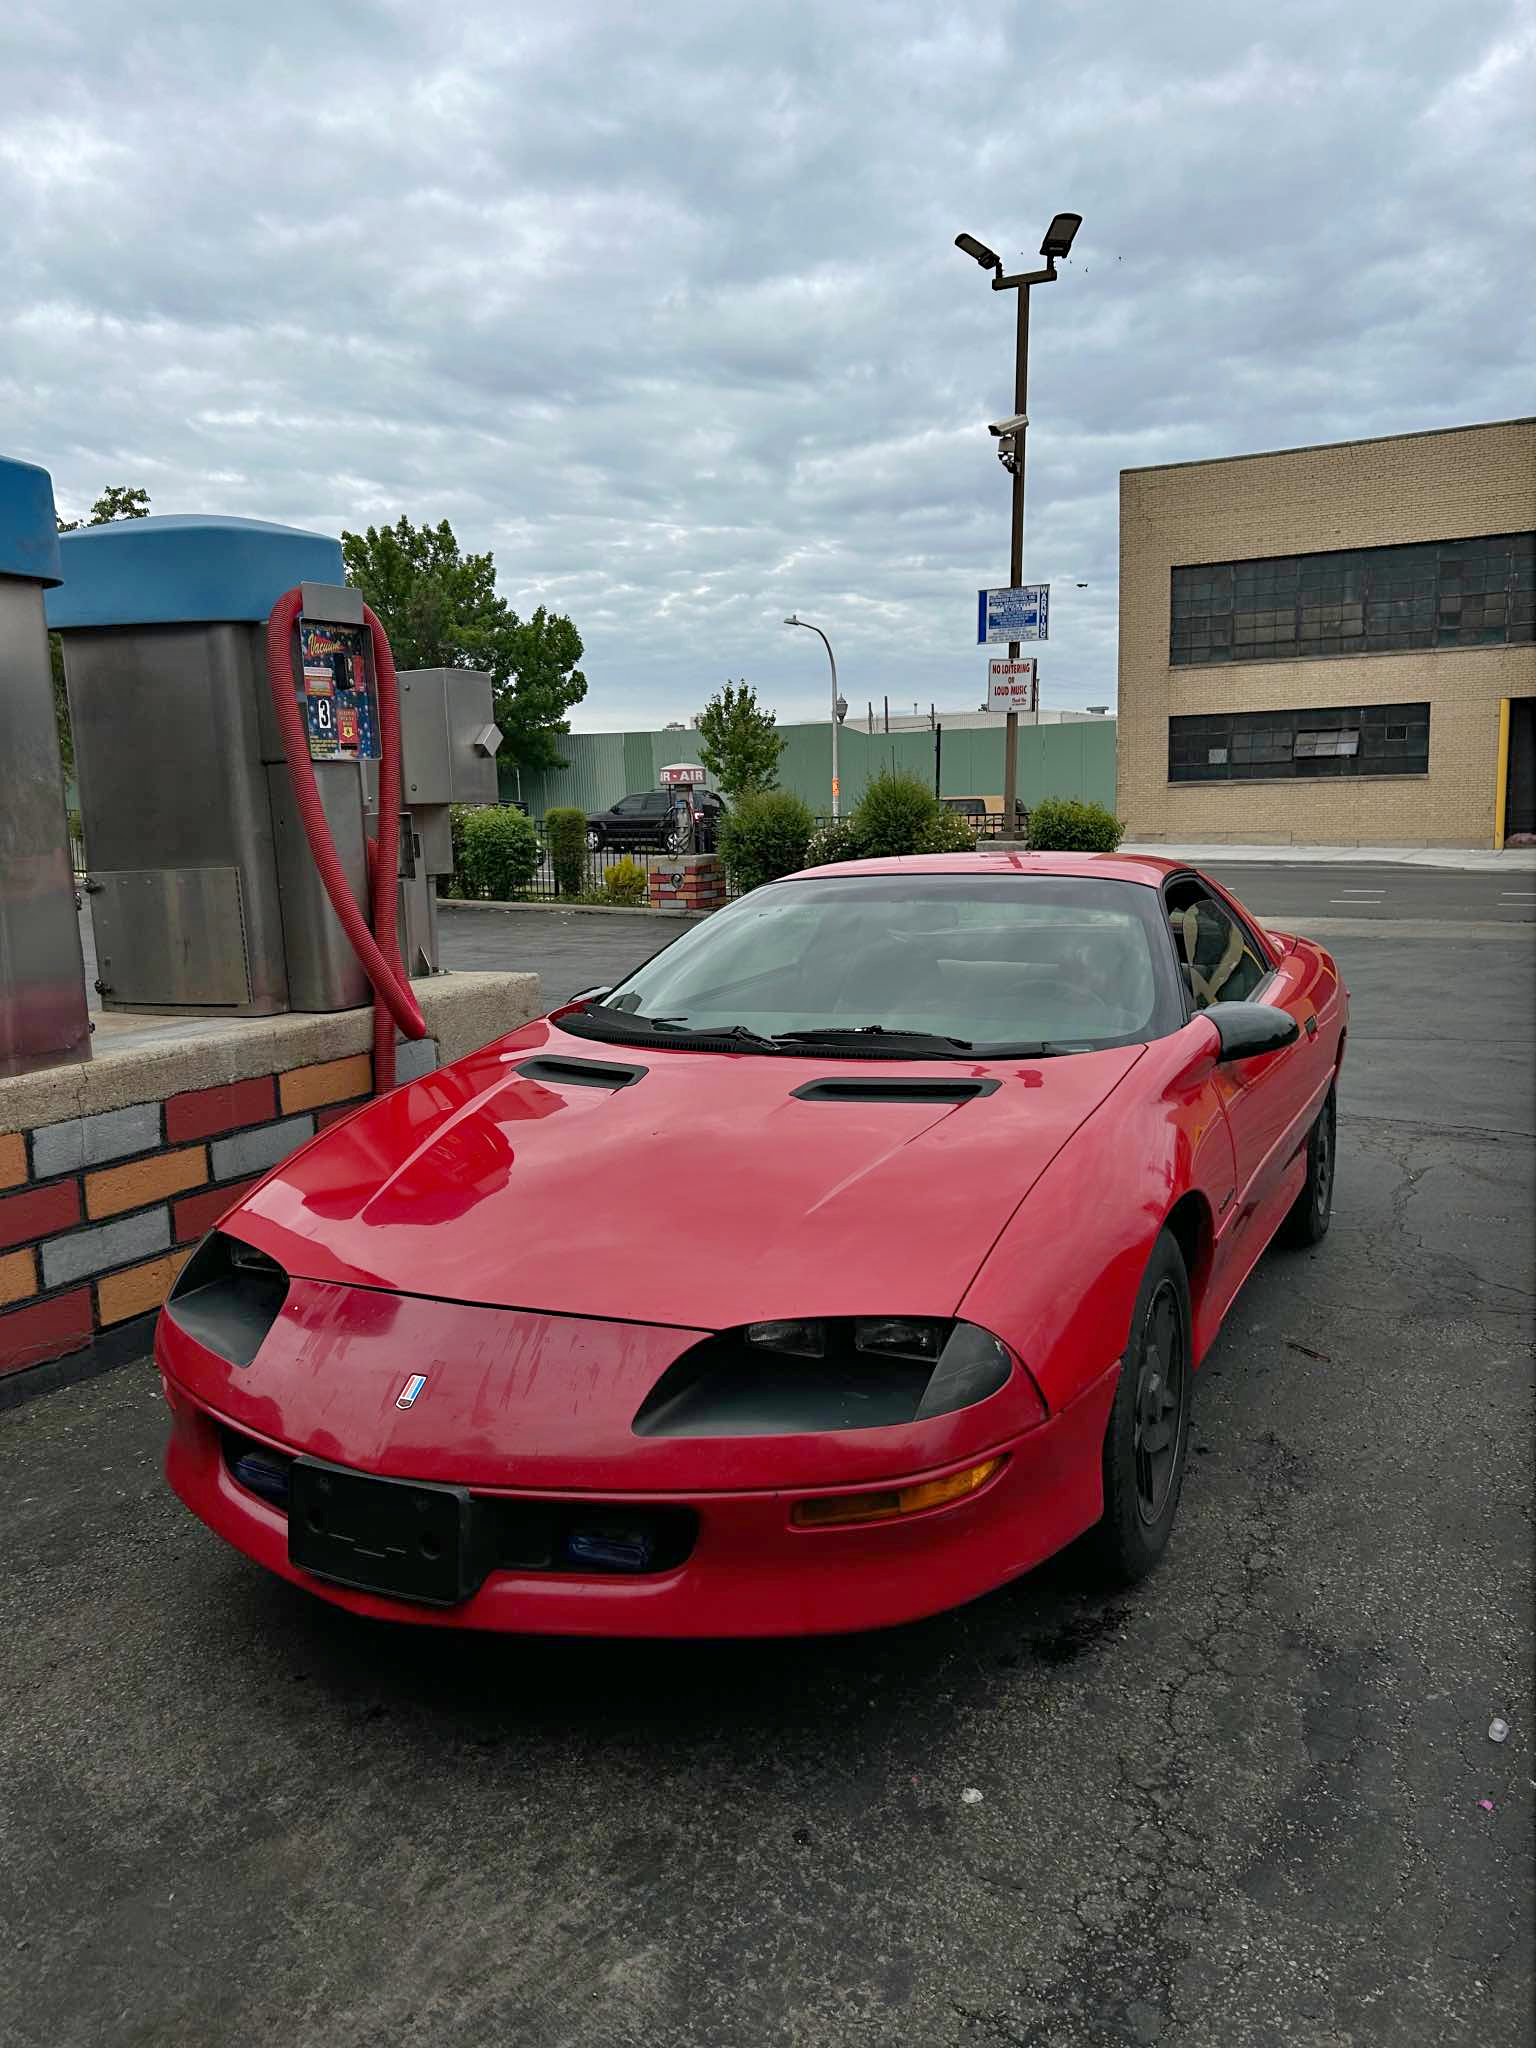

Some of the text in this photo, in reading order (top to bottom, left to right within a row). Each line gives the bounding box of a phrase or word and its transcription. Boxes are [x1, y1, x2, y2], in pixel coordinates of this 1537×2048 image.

[1040, 585, 1048, 638] WARNING
[308, 633, 341, 657] Vacuum
[992, 663, 1030, 674] NO LOITERING
[1008, 676, 1015, 684] OR
[994, 685, 1027, 696] LOUD MUSIC
[319, 700, 329, 727] 3
[680, 770, 703, 781] AIR
